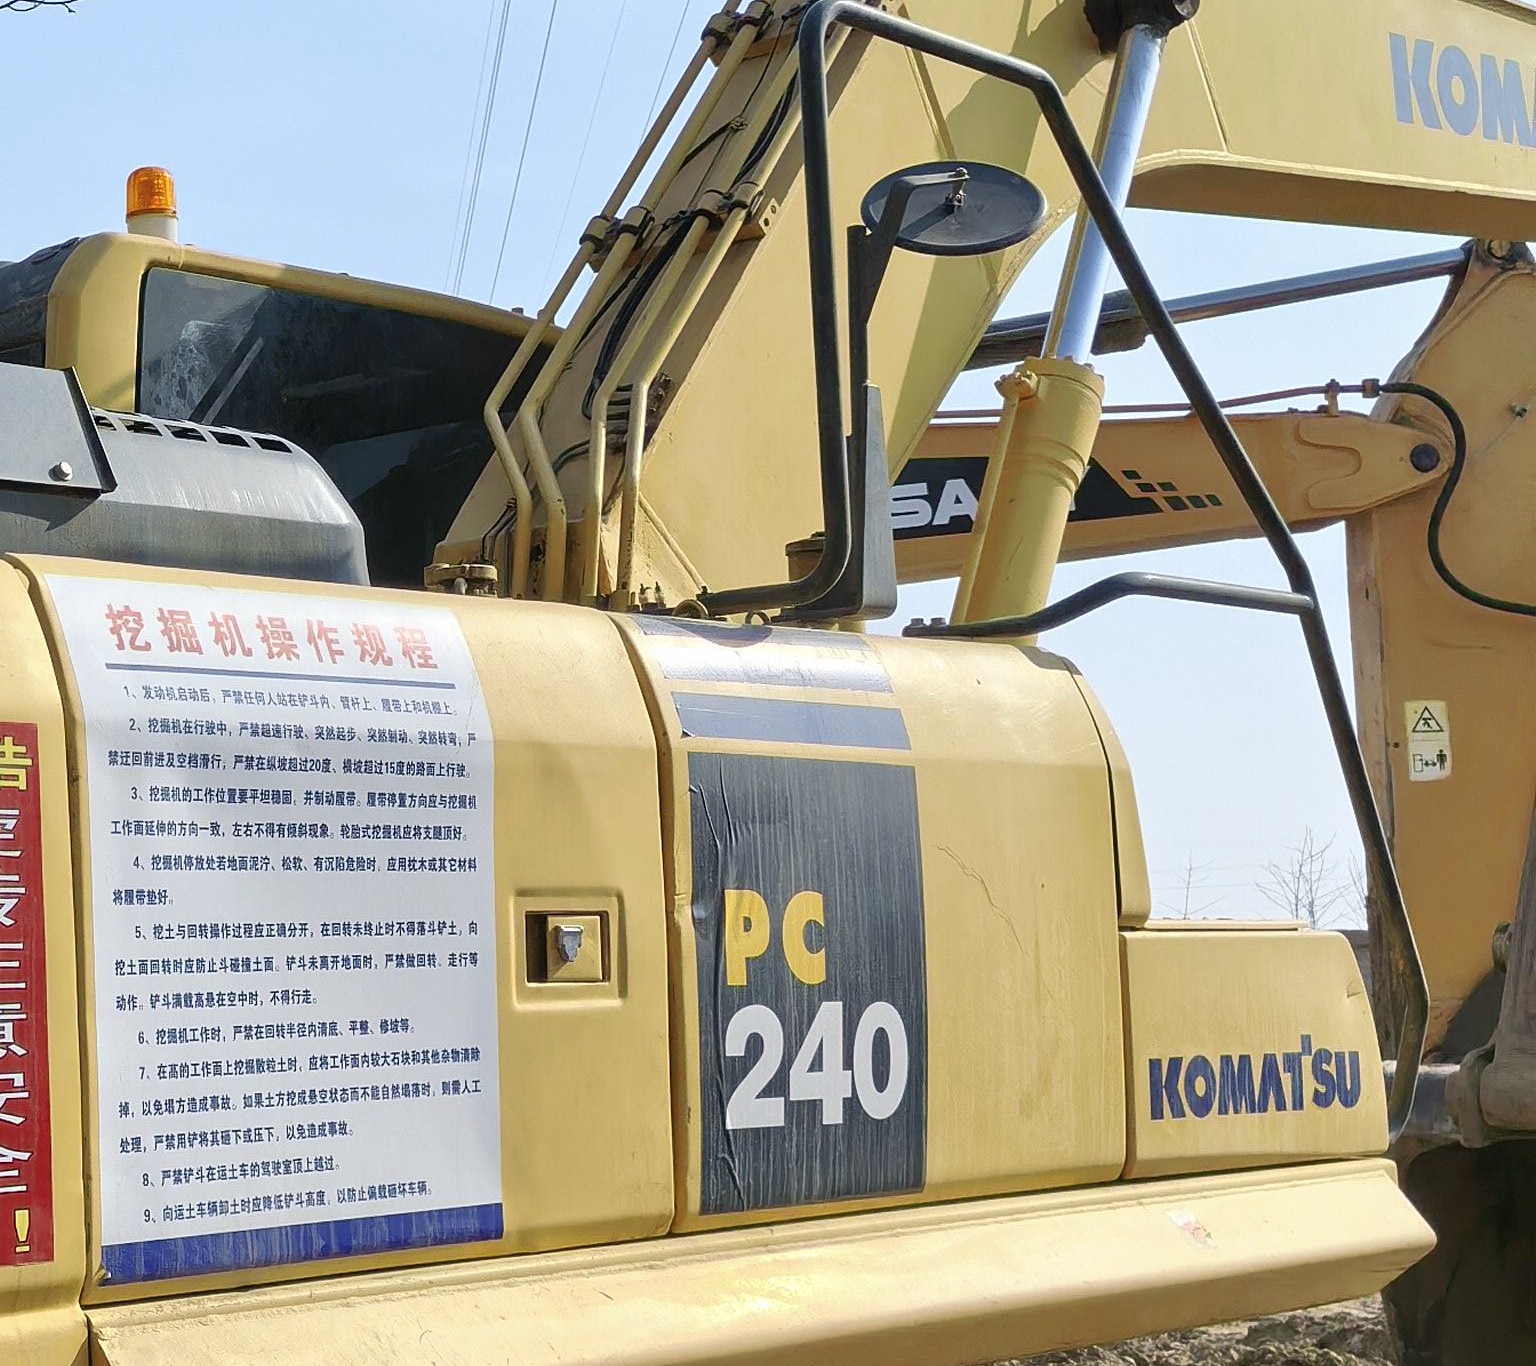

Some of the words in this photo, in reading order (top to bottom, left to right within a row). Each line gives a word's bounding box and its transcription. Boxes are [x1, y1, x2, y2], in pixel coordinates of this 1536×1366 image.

[1389, 32, 1536, 148] KOM
[104, 601, 440, 671] 挖掘机操作规程
[112, 889, 174, 906] 将履带垫好。
[724, 889, 827, 987] PC
[726, 1001, 908, 1130] 240
[1150, 1033, 1360, 1121] KOMATSU
